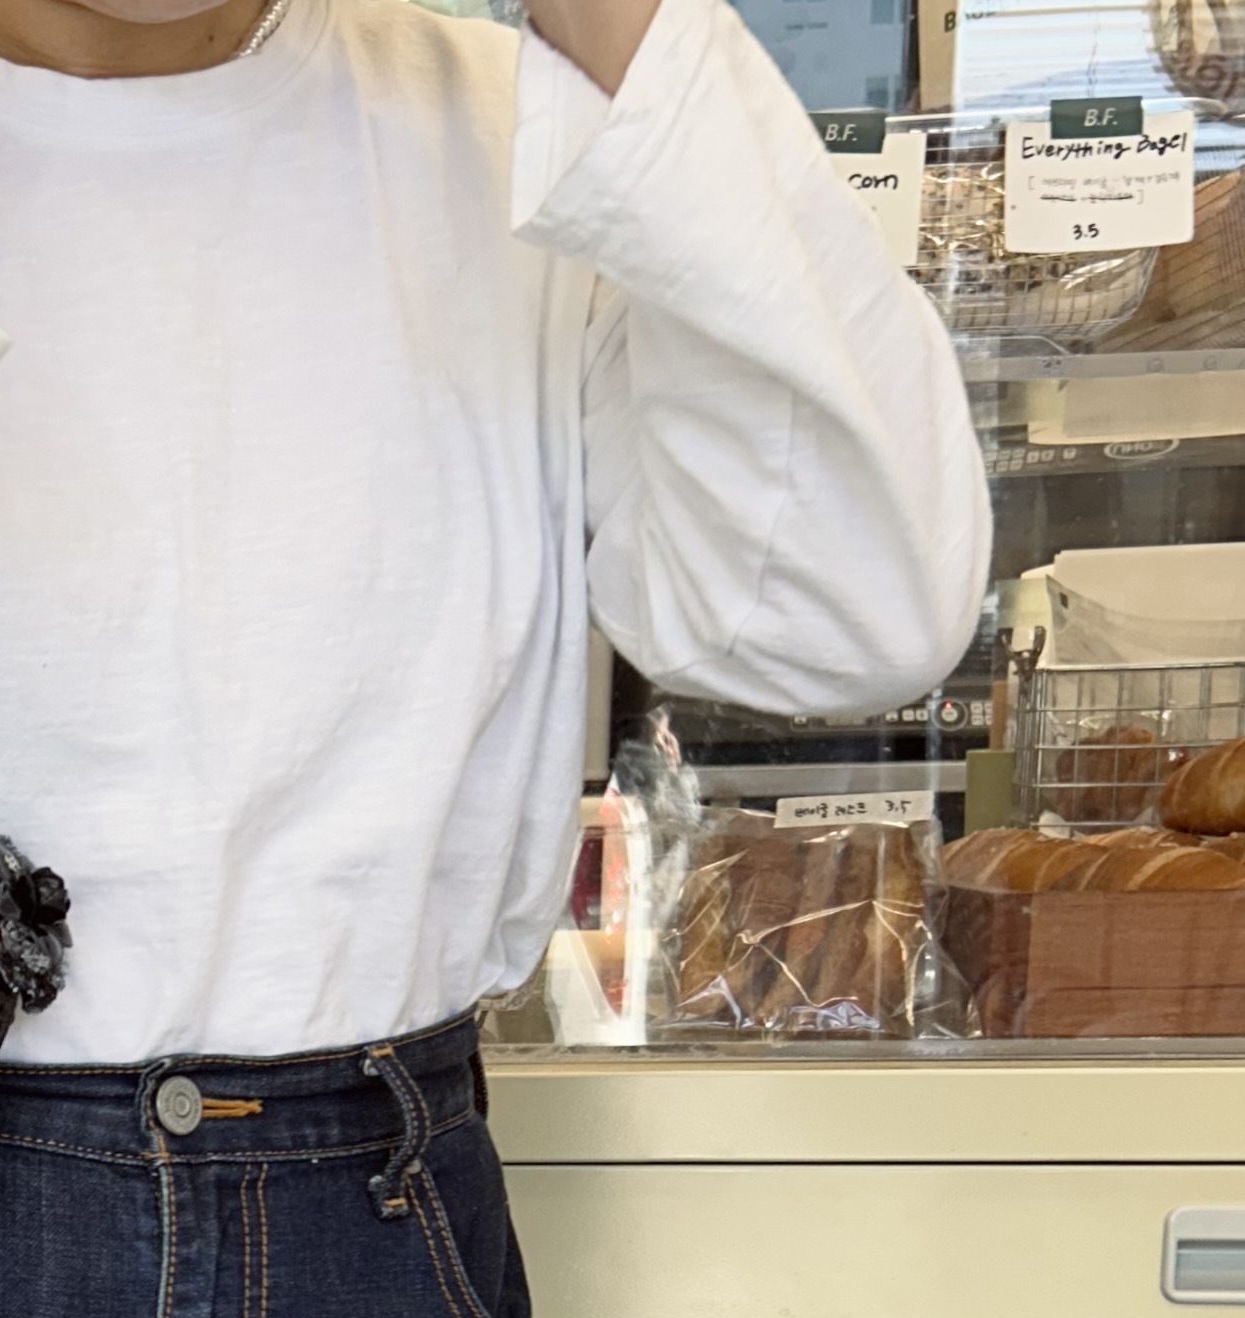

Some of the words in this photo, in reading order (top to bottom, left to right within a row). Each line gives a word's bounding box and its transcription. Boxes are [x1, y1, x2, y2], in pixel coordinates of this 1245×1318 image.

[1084, 107, 1118, 127] B.F.
[824, 123, 858, 142] B.F.
[1021, 136, 1131, 162] Everything
[1136, 132, 1188, 156] Bagel
[1072, 223, 1100, 240] 3.5
[884, 799, 912, 815] 3.5
